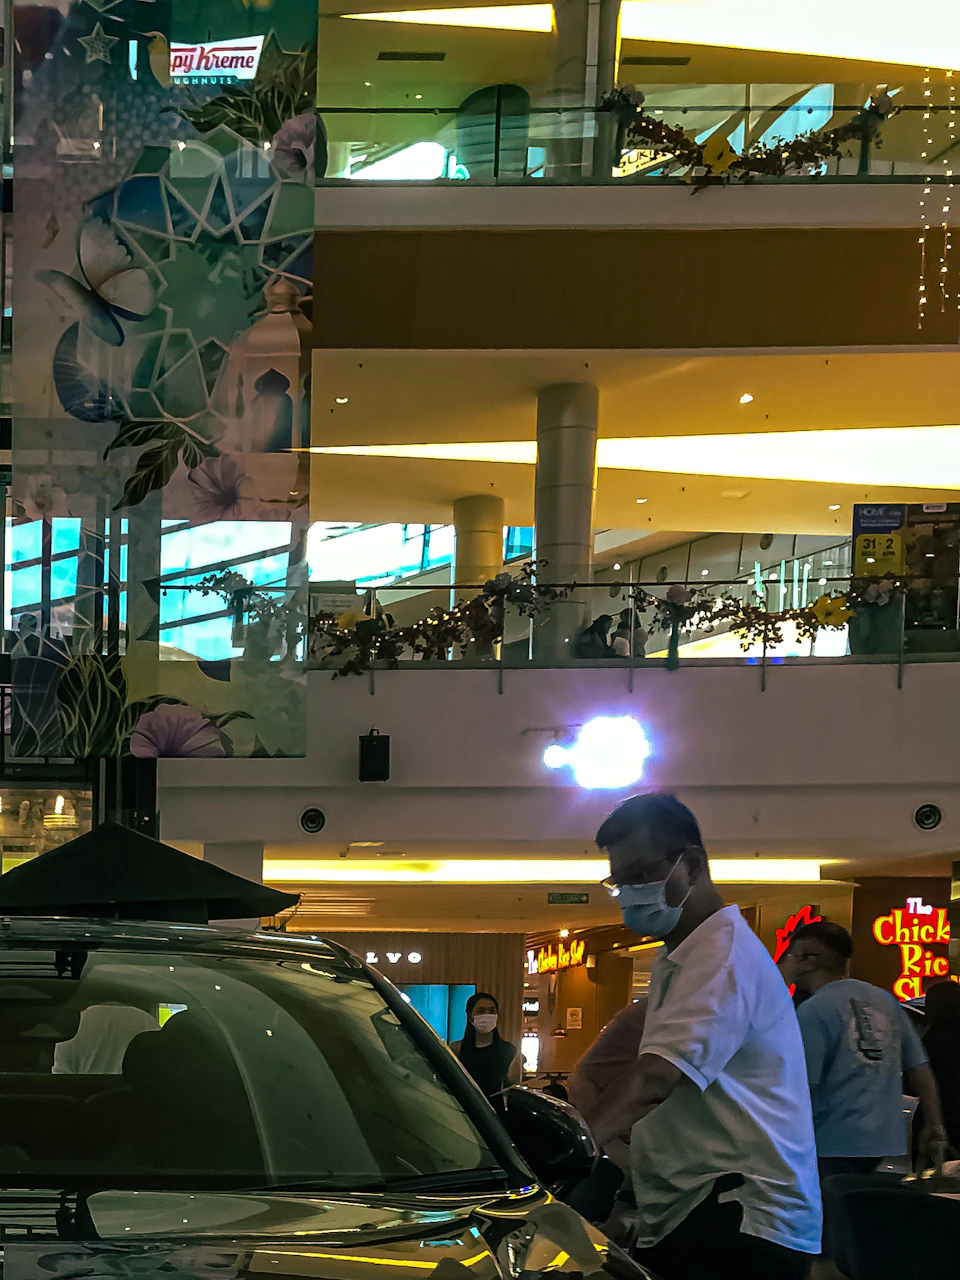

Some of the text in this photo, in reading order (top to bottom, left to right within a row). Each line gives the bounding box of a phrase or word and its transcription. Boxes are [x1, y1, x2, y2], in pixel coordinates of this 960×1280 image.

[173, 76, 232, 85] UGHNUTS
[863, 538, 876, 549] 31
[886, 538, 894, 549] 2
[906, 897, 933, 915] The
[873, 909, 950, 946] Chick
[365, 951, 422, 964] LVO
[901, 944, 948, 976] Ric
